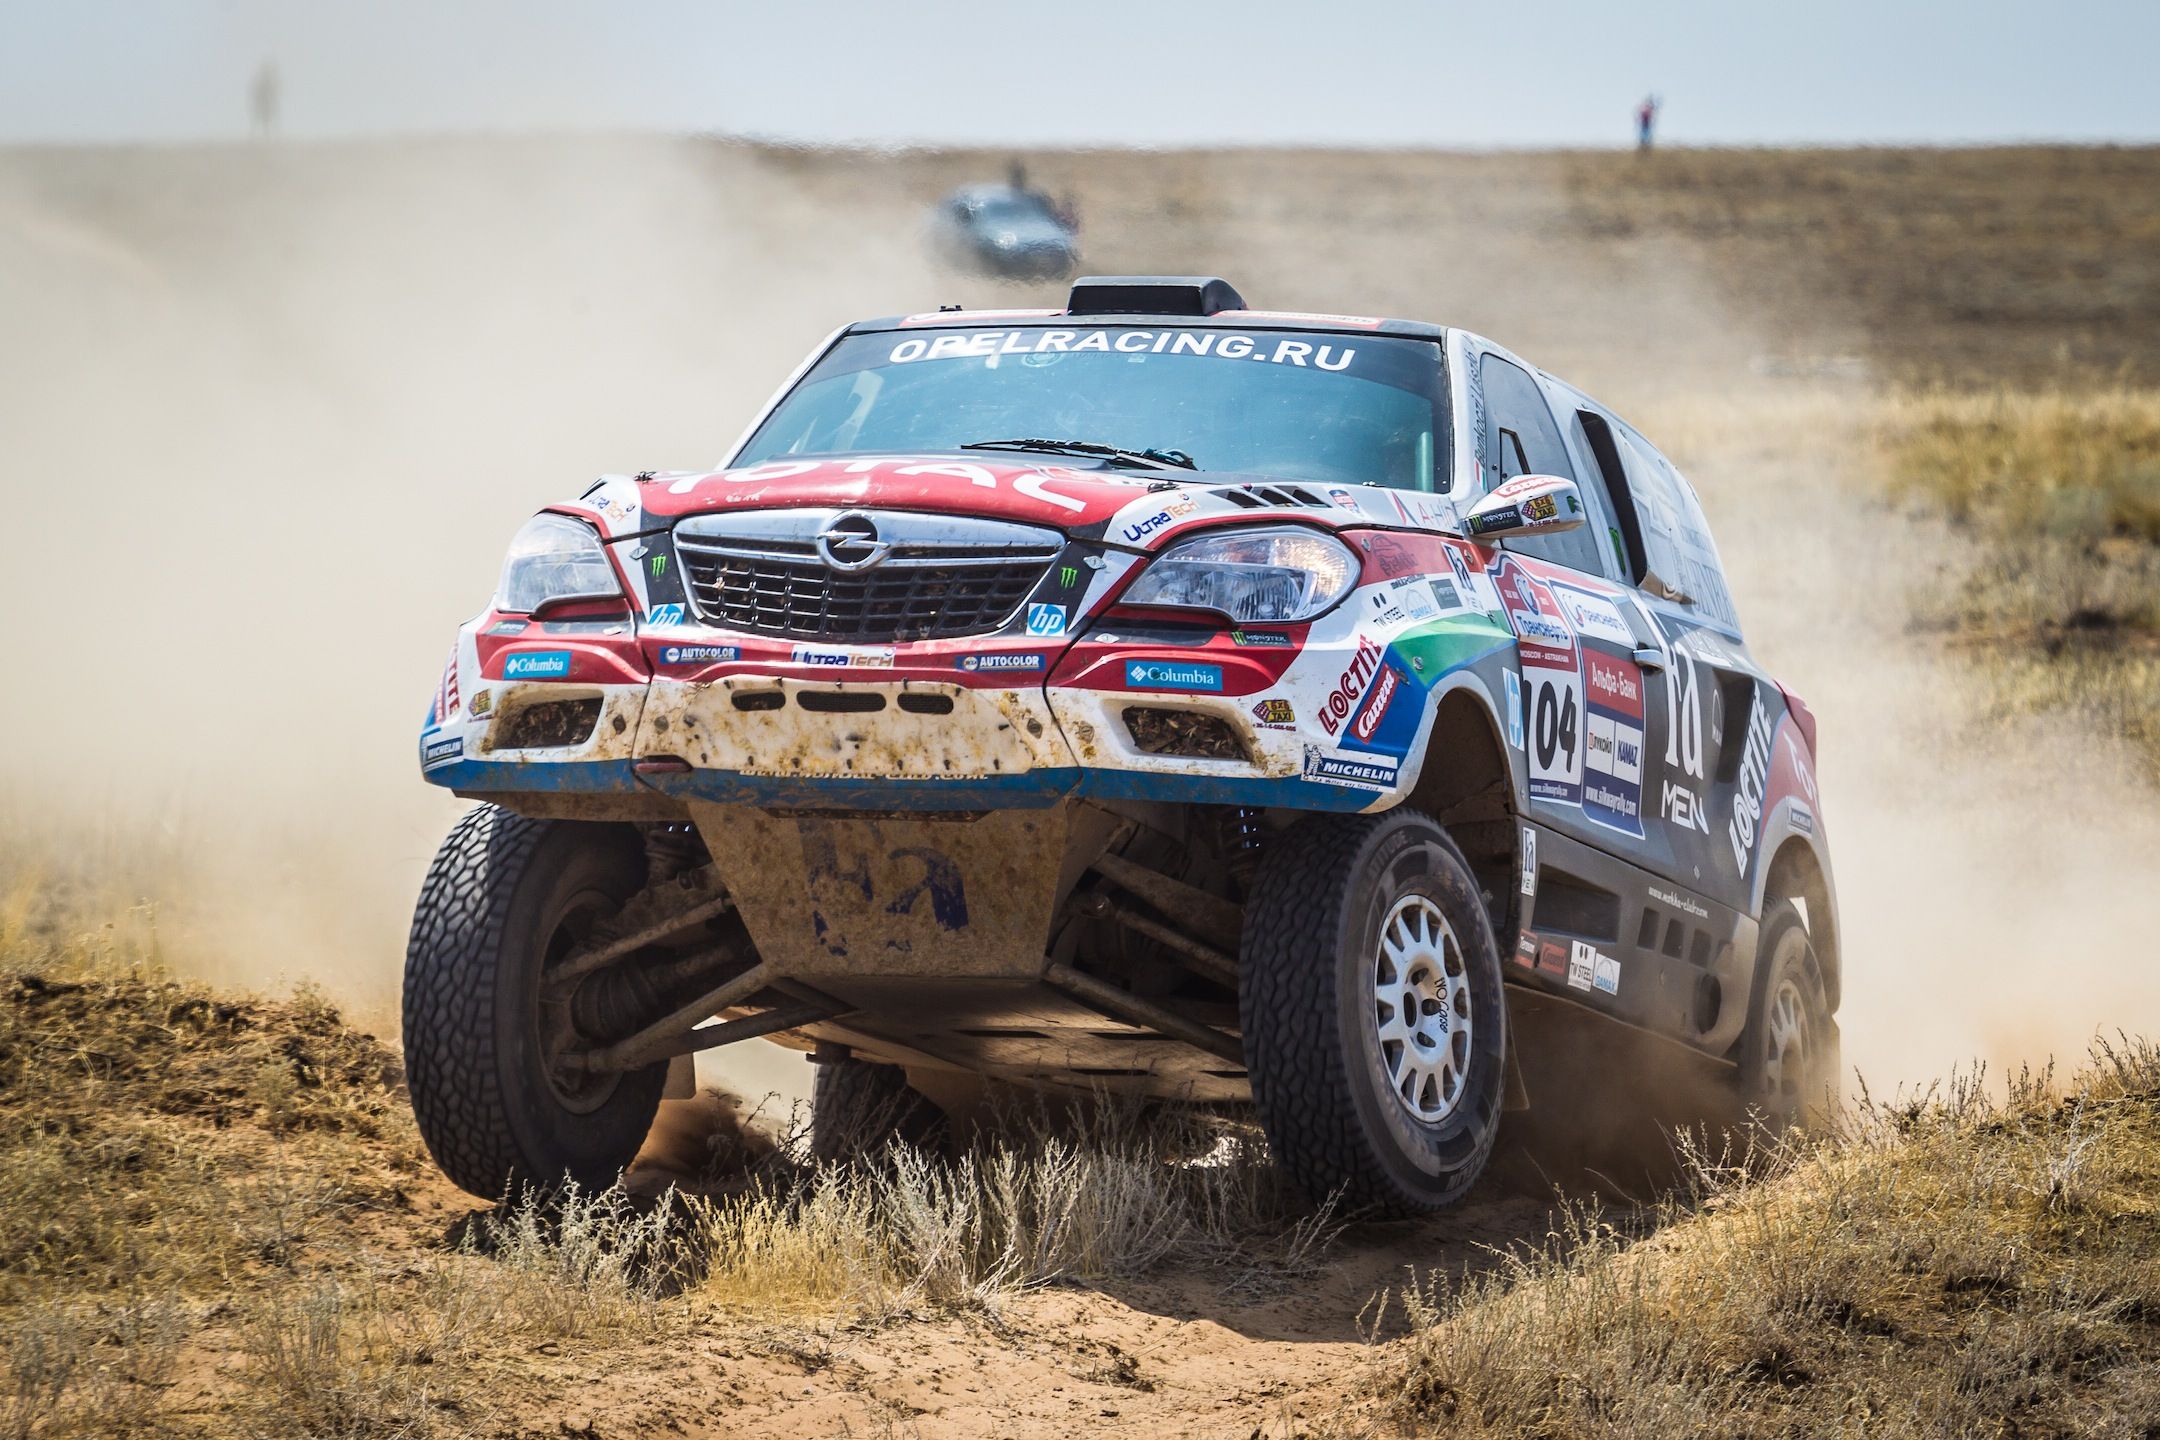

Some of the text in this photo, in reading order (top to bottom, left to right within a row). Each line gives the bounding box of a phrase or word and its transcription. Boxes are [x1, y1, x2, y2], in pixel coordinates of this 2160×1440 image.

[888, 331, 1356, 371] OPELRACING.RU
[1538, 506, 1555, 517] TAXI
[654, 603, 682, 628] hp
[1032, 605, 1062, 634] hp
[681, 647, 735, 658] AUTOCOLOR
[979, 655, 1040, 667] AUTOCOLOR
[517, 657, 564, 672] Columbia
[1147, 666, 1215, 686] Columbia
[1318, 634, 1382, 736] LOCTITE
[1358, 670, 1395, 738] Carrera
[1272, 712, 1291, 721] TAXI
[428, 741, 462, 759] MICHELIN
[1323, 762, 1394, 781] MICHELIN
[1729, 680, 1772, 880] LOCTITE
[1661, 780, 1709, 835] MEN
